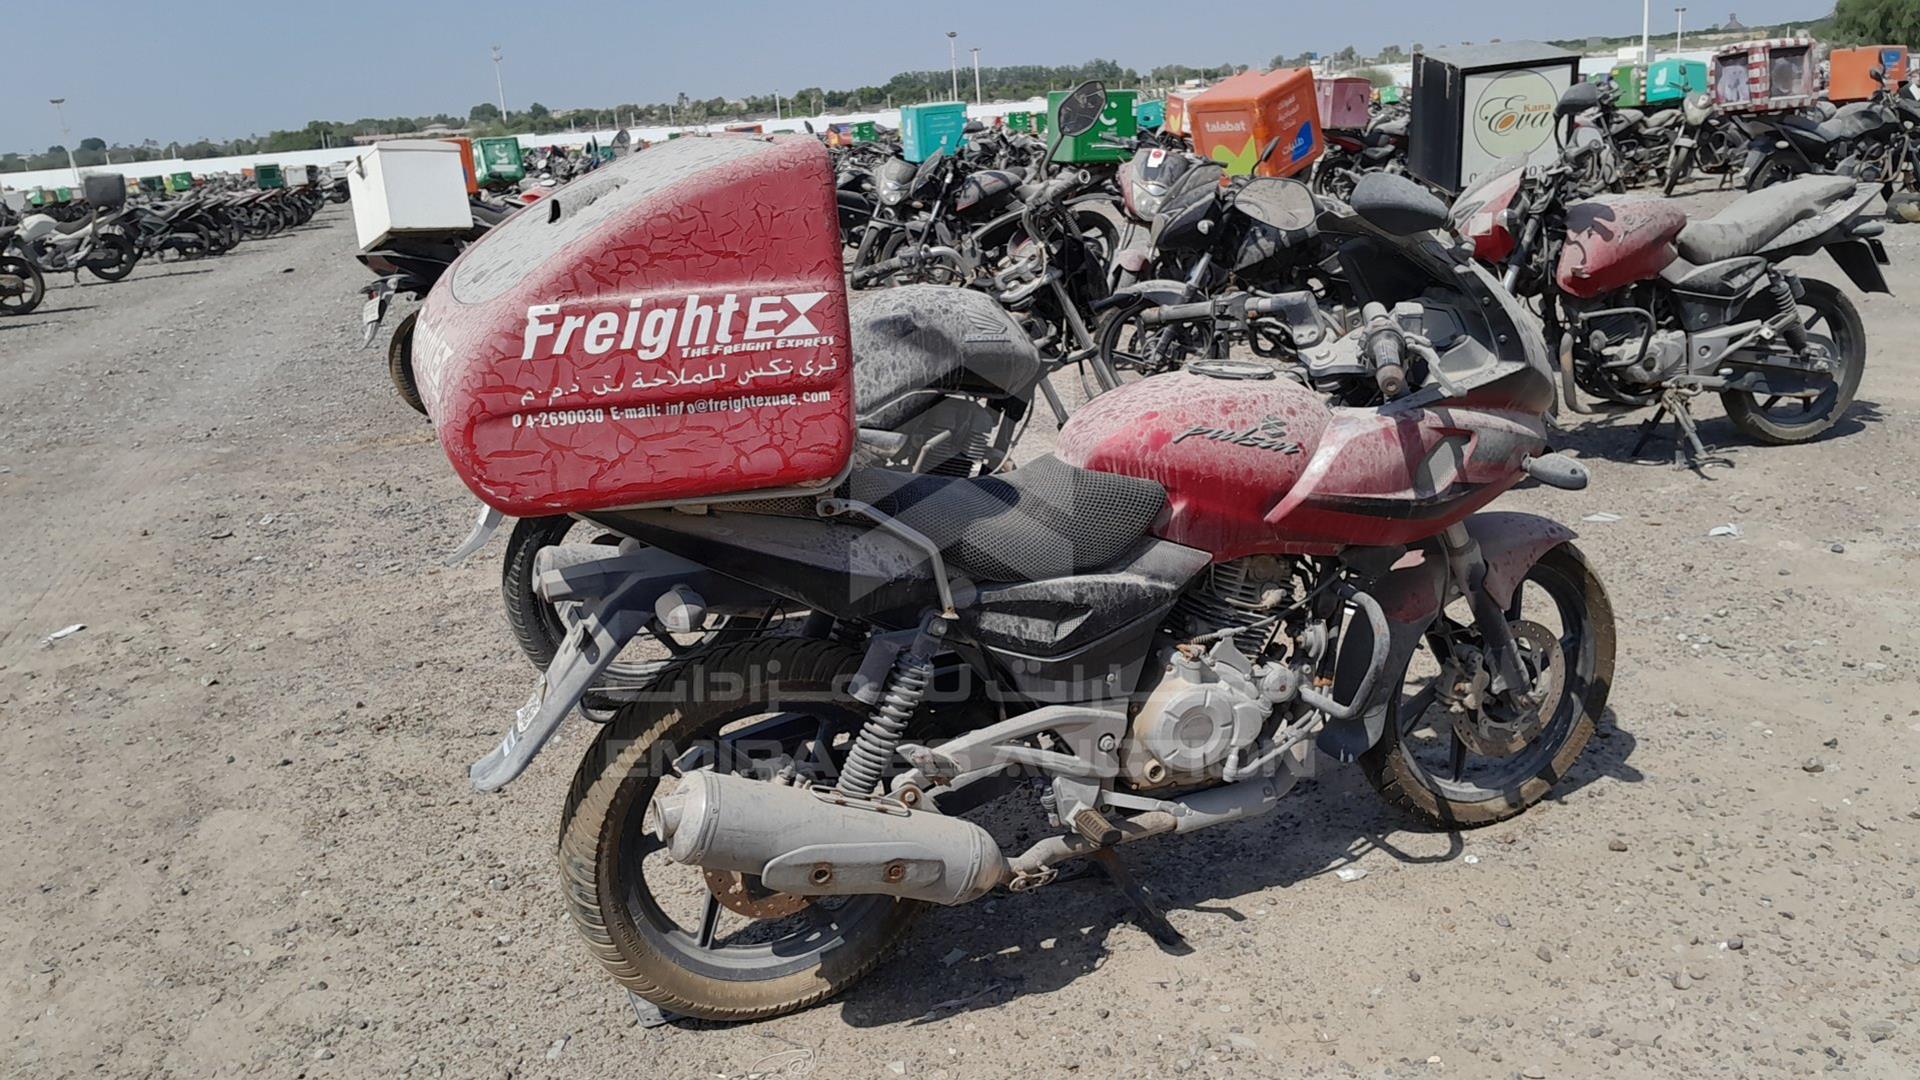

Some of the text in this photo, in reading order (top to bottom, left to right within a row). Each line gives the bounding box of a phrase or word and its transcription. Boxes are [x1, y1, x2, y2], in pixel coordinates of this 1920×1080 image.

[1523, 103, 1551, 112] Kana
[1205, 120, 1246, 133] talabat
[682, 335, 835, 359] THE FREIGHT EXPRESS
[630, 363, 727, 388] للملاحة
[610, 402, 662, 421] E-mail:
